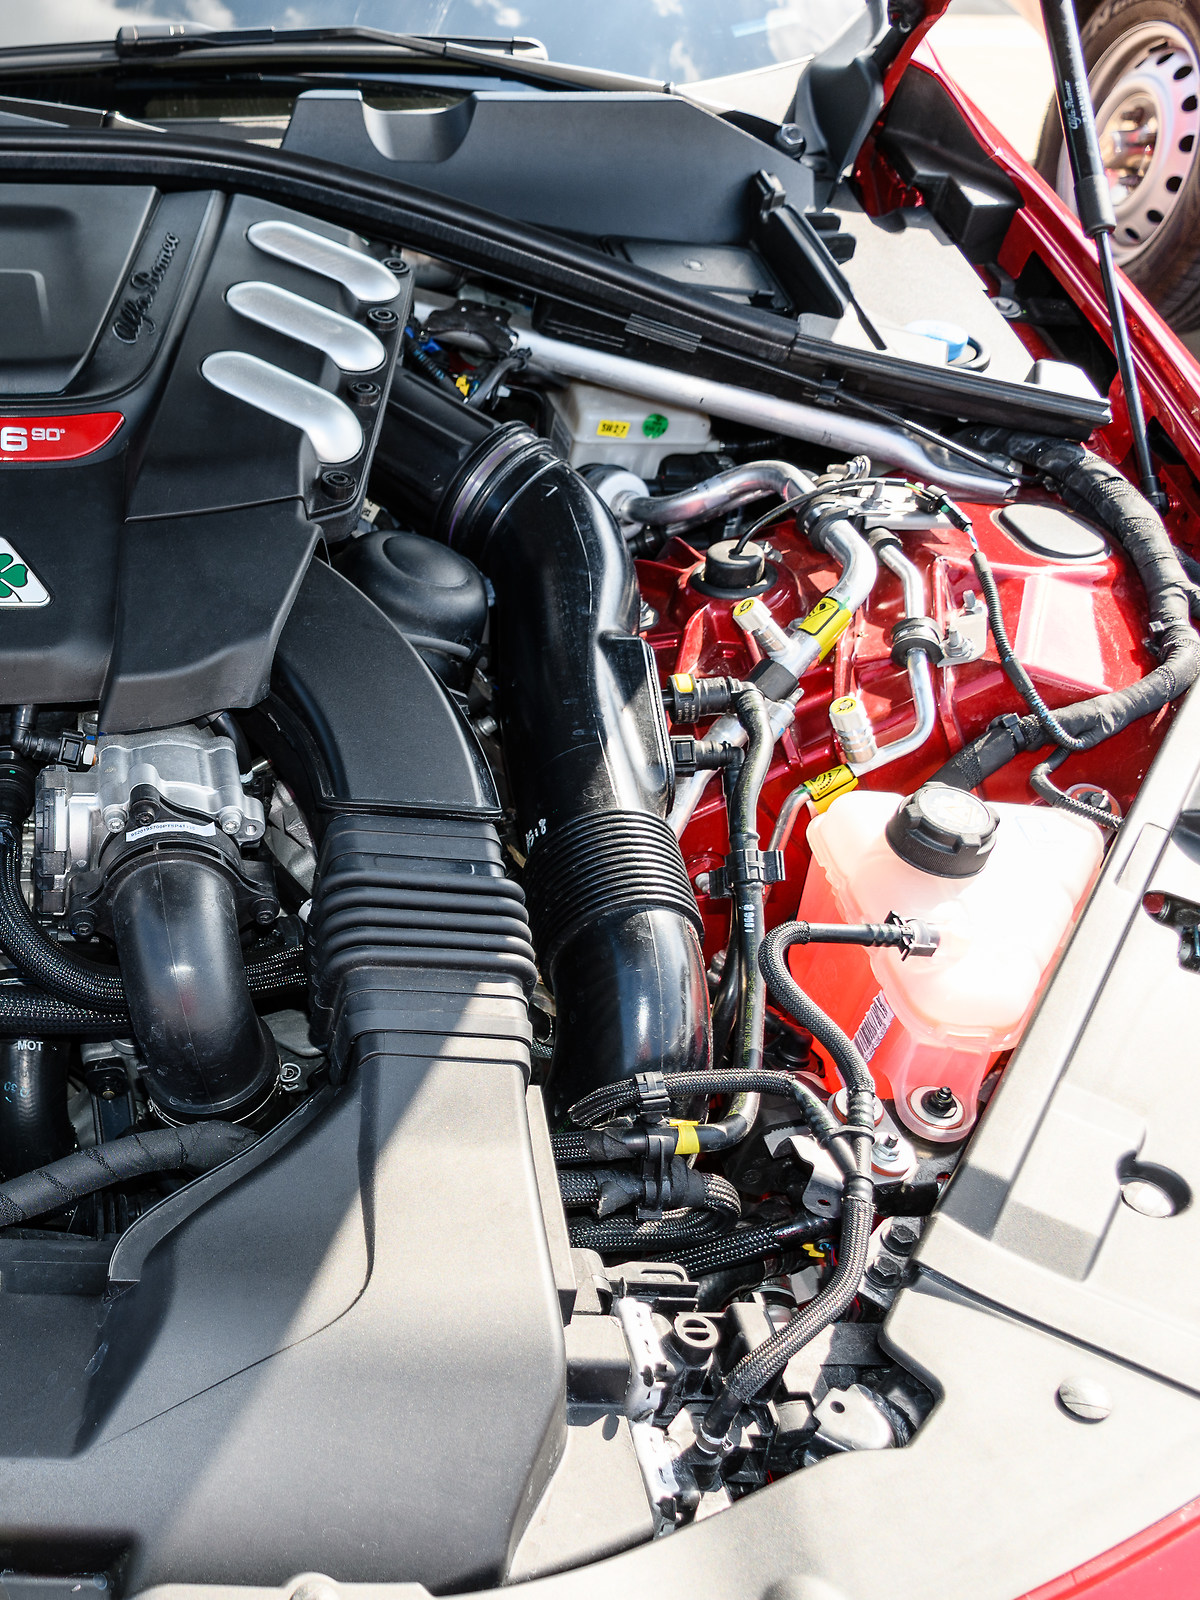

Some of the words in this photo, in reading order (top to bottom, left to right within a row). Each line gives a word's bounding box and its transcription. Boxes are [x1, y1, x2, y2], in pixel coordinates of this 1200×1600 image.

[130, 231, 180, 295] Romeo
[112, 292, 156, 344] Alfa
[17, 1040, 44, 1052] MOT
